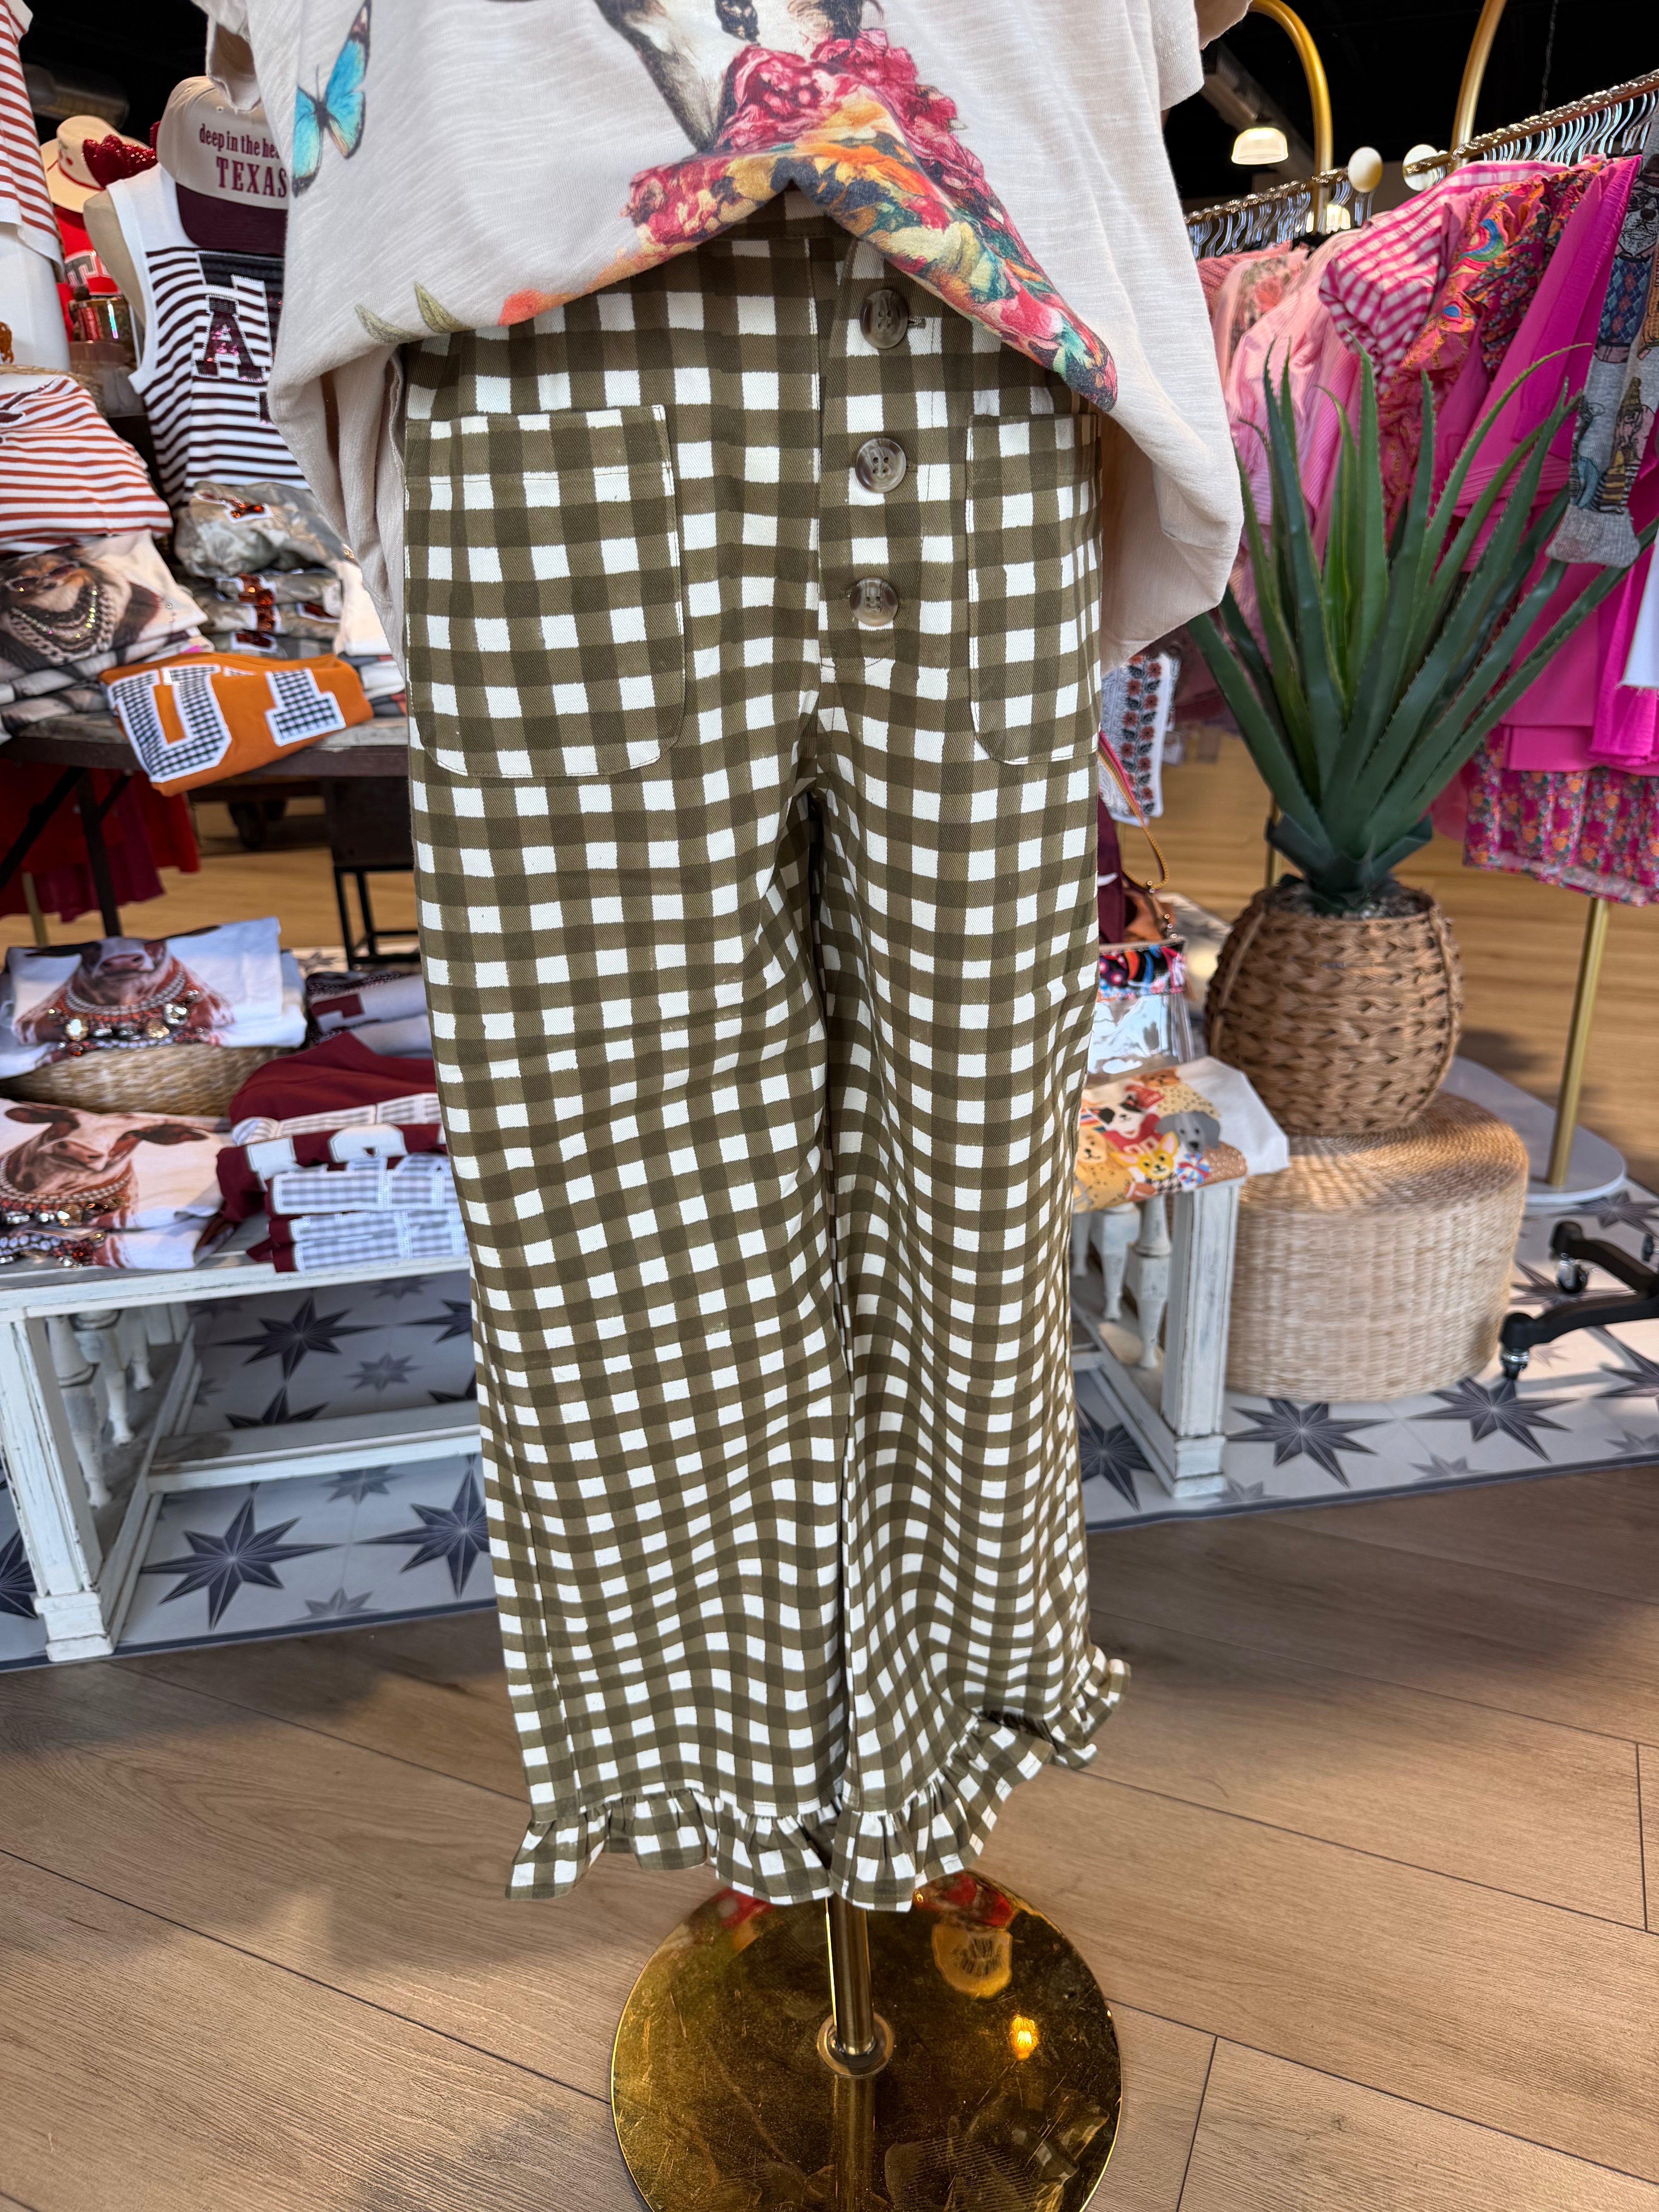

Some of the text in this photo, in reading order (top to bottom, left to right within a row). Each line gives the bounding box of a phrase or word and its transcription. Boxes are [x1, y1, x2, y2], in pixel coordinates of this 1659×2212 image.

[199, 123, 224, 152] deep
[226, 130, 239, 152] in
[241, 134, 260, 156] the
[216, 156, 287, 198] TEXAS
